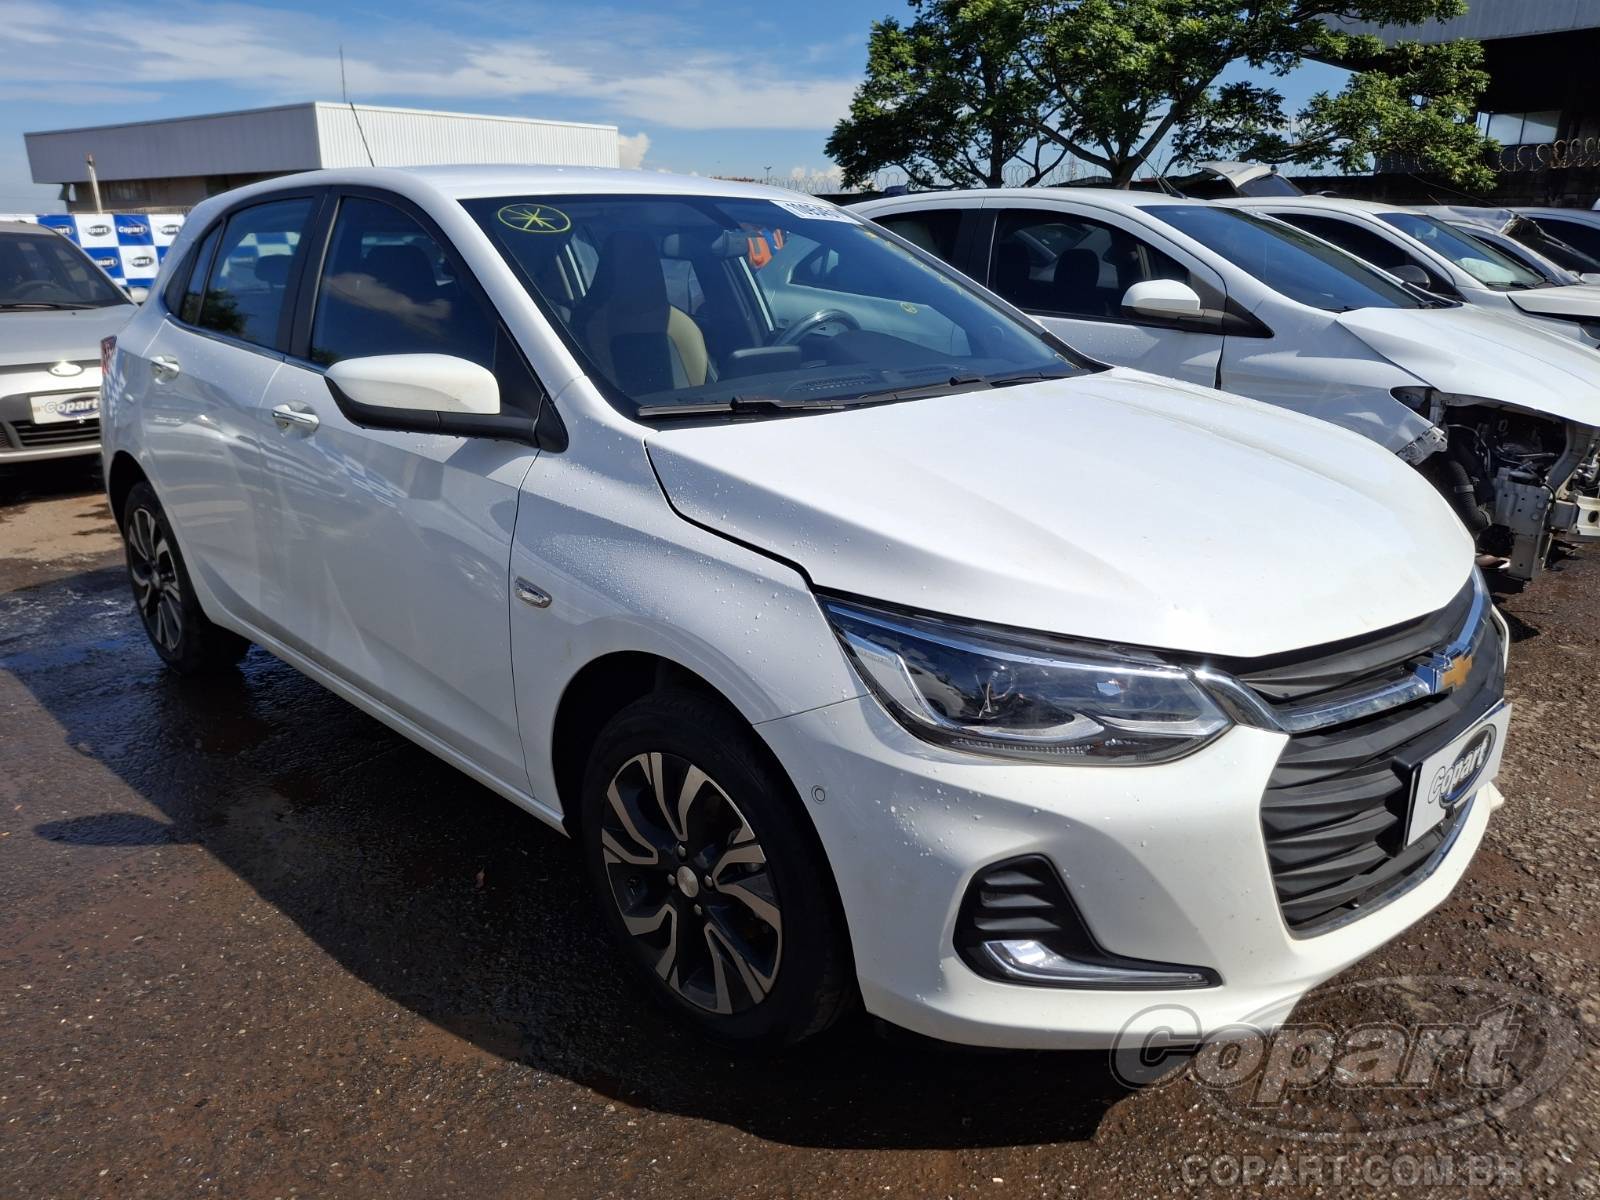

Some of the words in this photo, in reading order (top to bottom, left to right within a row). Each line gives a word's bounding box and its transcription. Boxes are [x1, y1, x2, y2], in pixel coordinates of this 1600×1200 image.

[118, 226, 144, 234] Copart
[46, 398, 98, 414] Copart
[1428, 733, 1490, 804] Copart
